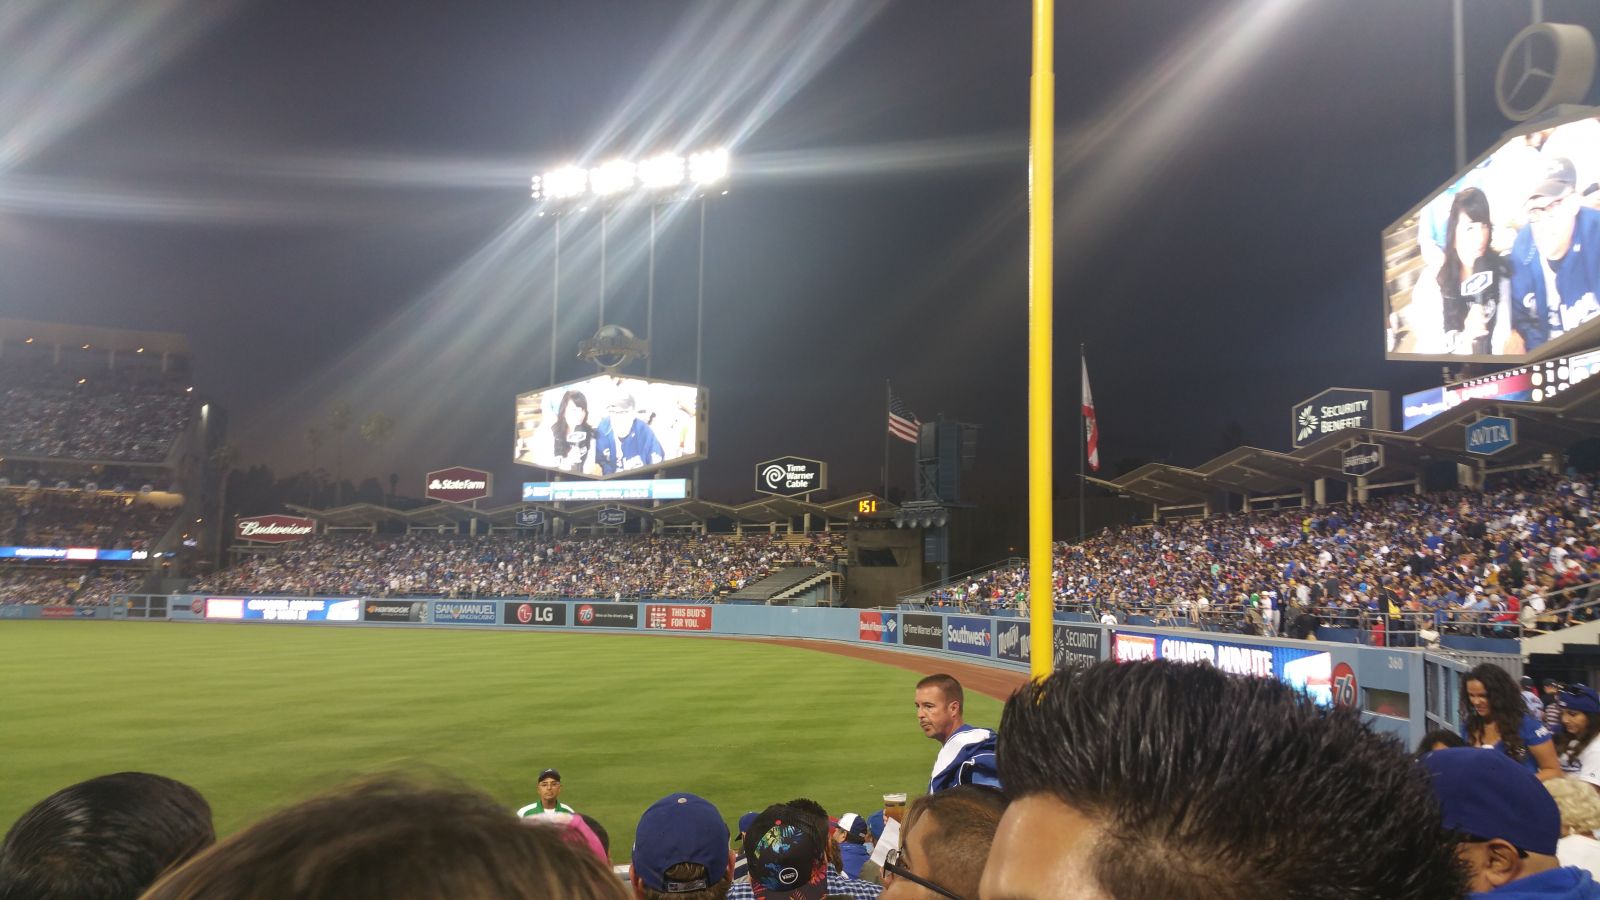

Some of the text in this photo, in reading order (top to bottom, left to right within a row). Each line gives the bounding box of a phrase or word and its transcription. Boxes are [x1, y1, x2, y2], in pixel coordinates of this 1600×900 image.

[1321, 400, 1368, 418] SECURITY
[1321, 416, 1362, 433] BENEFIT
[786, 464, 806, 472] Time
[786, 472, 814, 480] Warner
[786, 480, 808, 488] Cable
[239, 521, 313, 536] Budweiser
[435, 604, 495, 615] SAN MANUEL
[535, 607, 554, 622] LG
[579, 606, 593, 622] 76
[671, 608, 706, 618] THIS BUD'S
[671, 618, 700, 628] FOR YOU.
[948, 624, 986, 647] Southwest
[1065, 629, 1098, 650] SECURITY
[1333, 674, 1355, 706] 76
